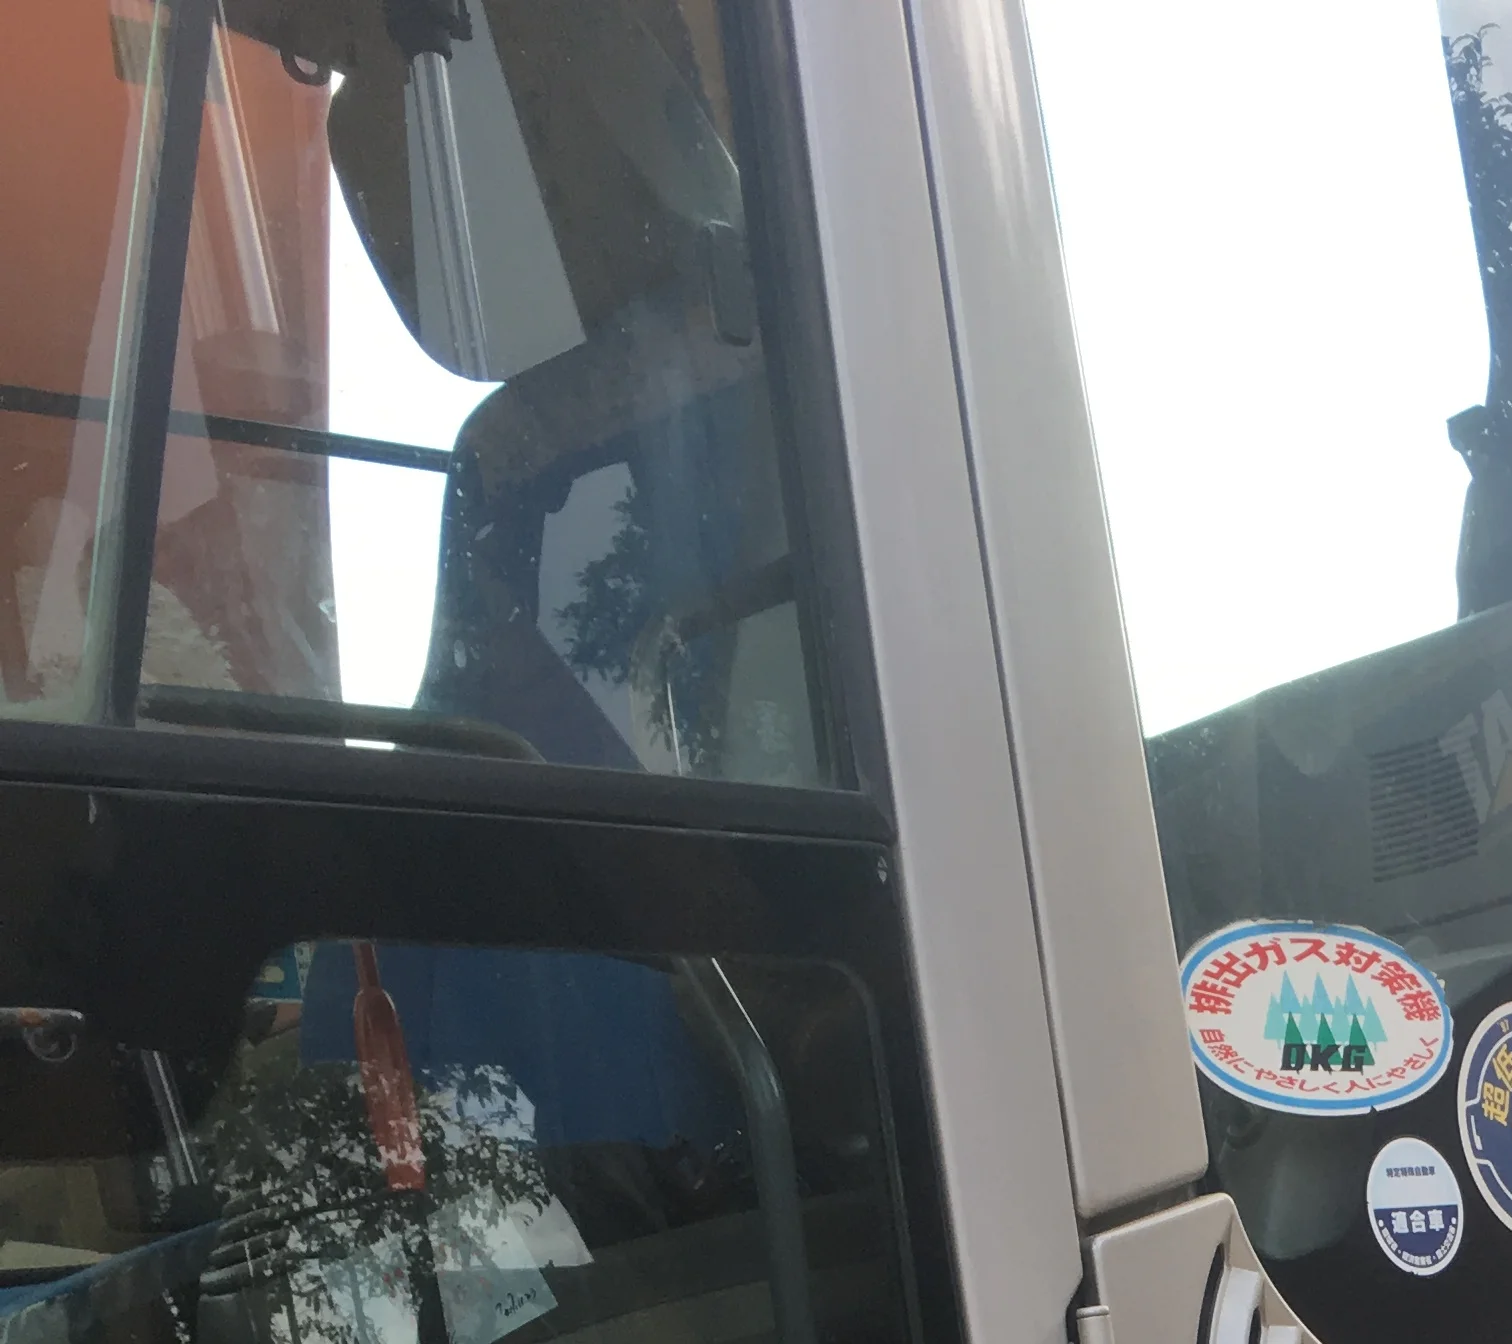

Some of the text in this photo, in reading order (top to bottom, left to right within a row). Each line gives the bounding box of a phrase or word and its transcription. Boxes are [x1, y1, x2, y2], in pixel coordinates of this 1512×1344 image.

[1189, 937, 1441, 1022] 排出ガス対策機
[1199, 1028, 1438, 1094] 自然にやさしく人にやさしく
